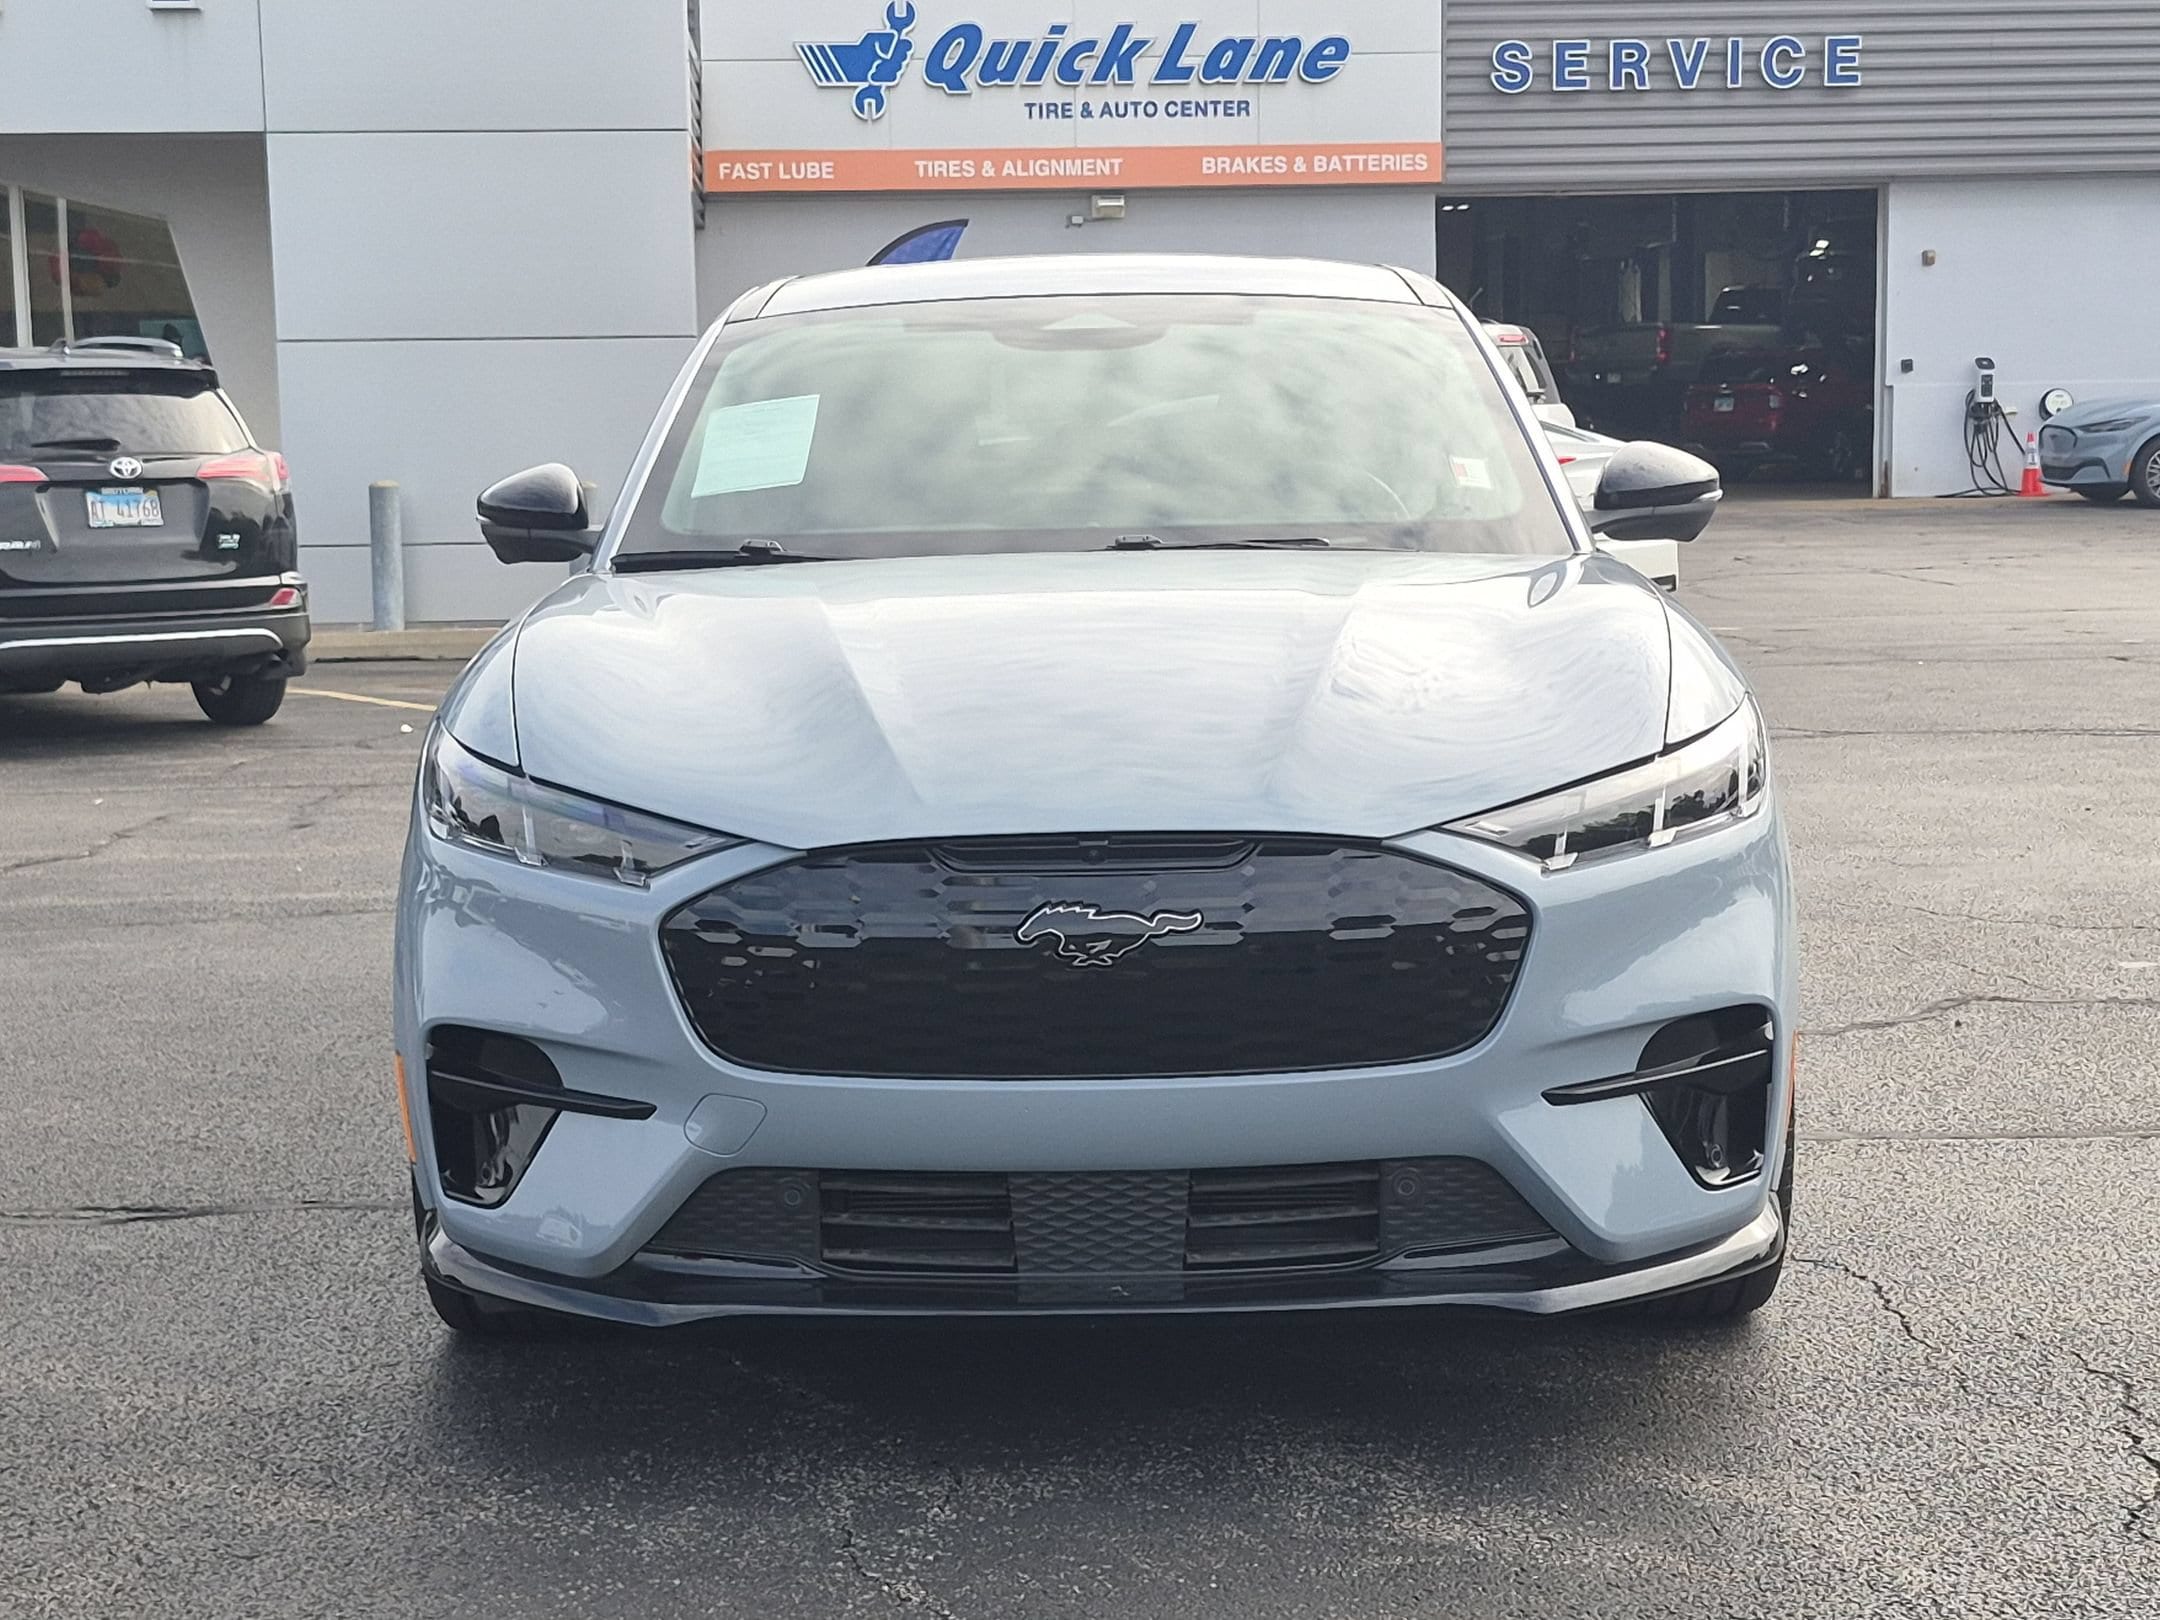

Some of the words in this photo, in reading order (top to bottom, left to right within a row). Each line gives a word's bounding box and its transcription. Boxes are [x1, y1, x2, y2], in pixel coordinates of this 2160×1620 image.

[923, 20, 1158, 94] Quick
[1150, 20, 1352, 84] Lane
[1491, 35, 1863, 93] SERVICE
[1024, 102, 1073, 119] TIRE
[1080, 102, 1094, 119] &
[1099, 101, 1158, 118] AUTO
[1164, 100, 1250, 118] CENTER
[719, 162, 772, 180] FAST
[779, 161, 834, 179] LUBE
[914, 160, 976, 178] TIRES
[981, 160, 996, 177] &
[1001, 158, 1123, 177] ALIGNMENT
[1202, 156, 1287, 174] BRAKES
[1293, 156, 1307, 173] &
[1313, 153, 1428, 173] BATTERIES
